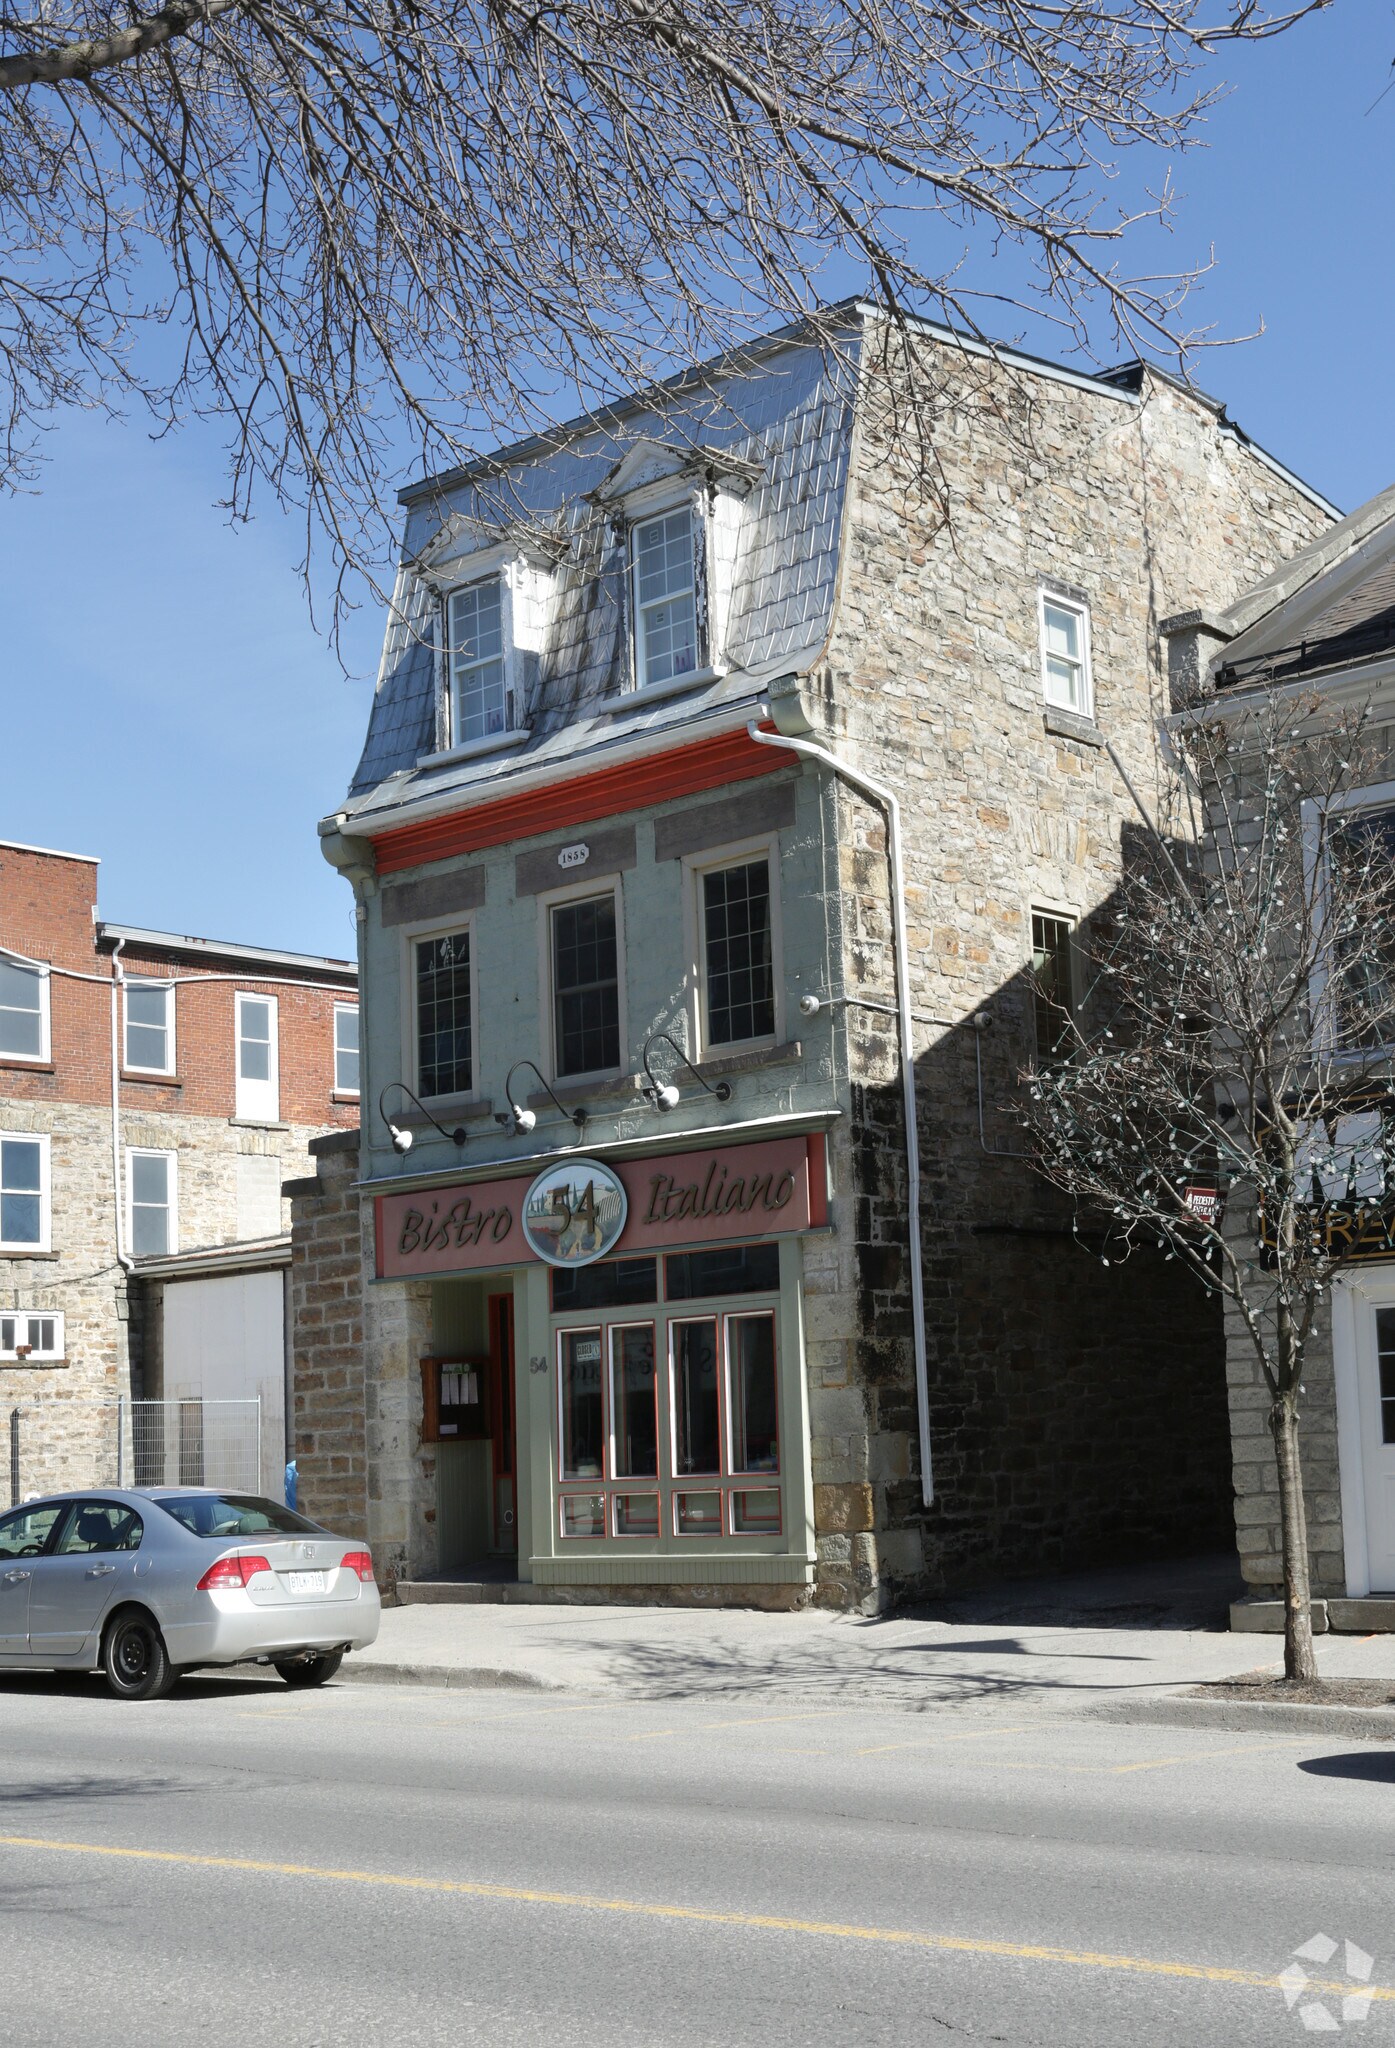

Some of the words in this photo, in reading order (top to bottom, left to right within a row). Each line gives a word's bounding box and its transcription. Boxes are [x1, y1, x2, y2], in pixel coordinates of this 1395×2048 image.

[562, 848, 586, 864] 1858
[397, 1197, 513, 1256] Bistro
[549, 1179, 600, 1236] 54
[643, 1159, 796, 1226] Italiano
[529, 1356, 548, 1375] 54
